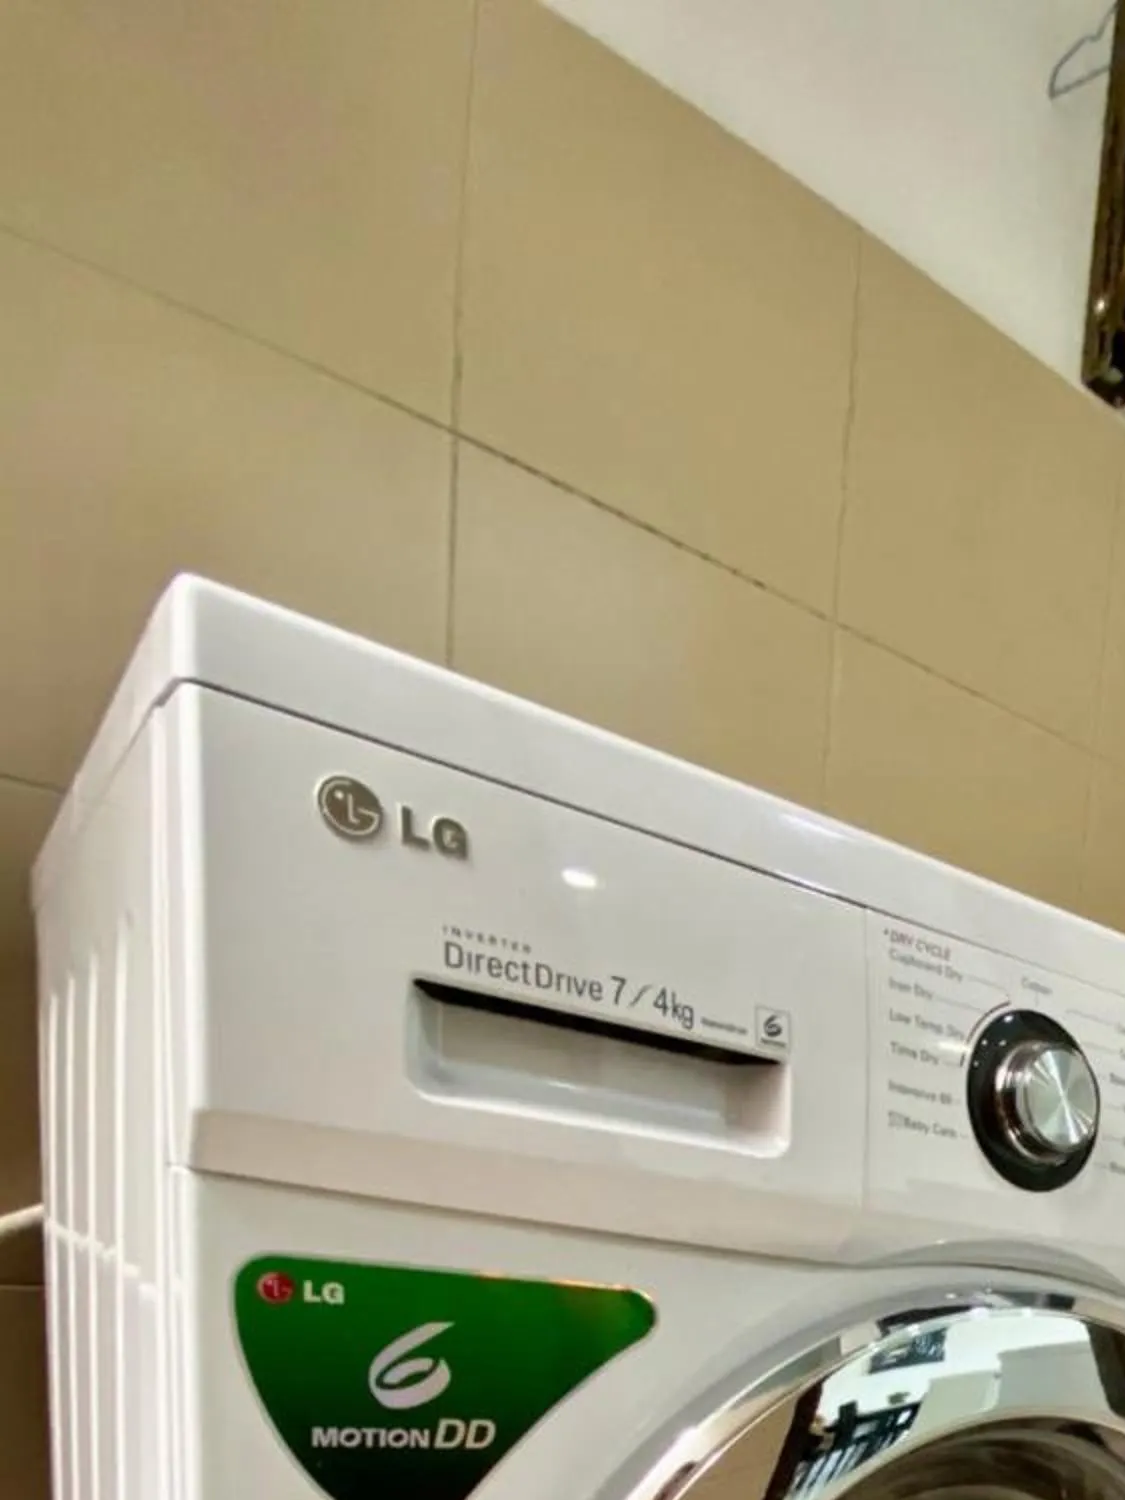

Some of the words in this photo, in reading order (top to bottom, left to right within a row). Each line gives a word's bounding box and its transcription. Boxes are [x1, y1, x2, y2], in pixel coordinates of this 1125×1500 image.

[401, 804, 468, 860] LG
[303, 1279, 346, 1306] LG
[367, 1321, 455, 1410] 6
[311, 1426, 432, 1449] MOTION
